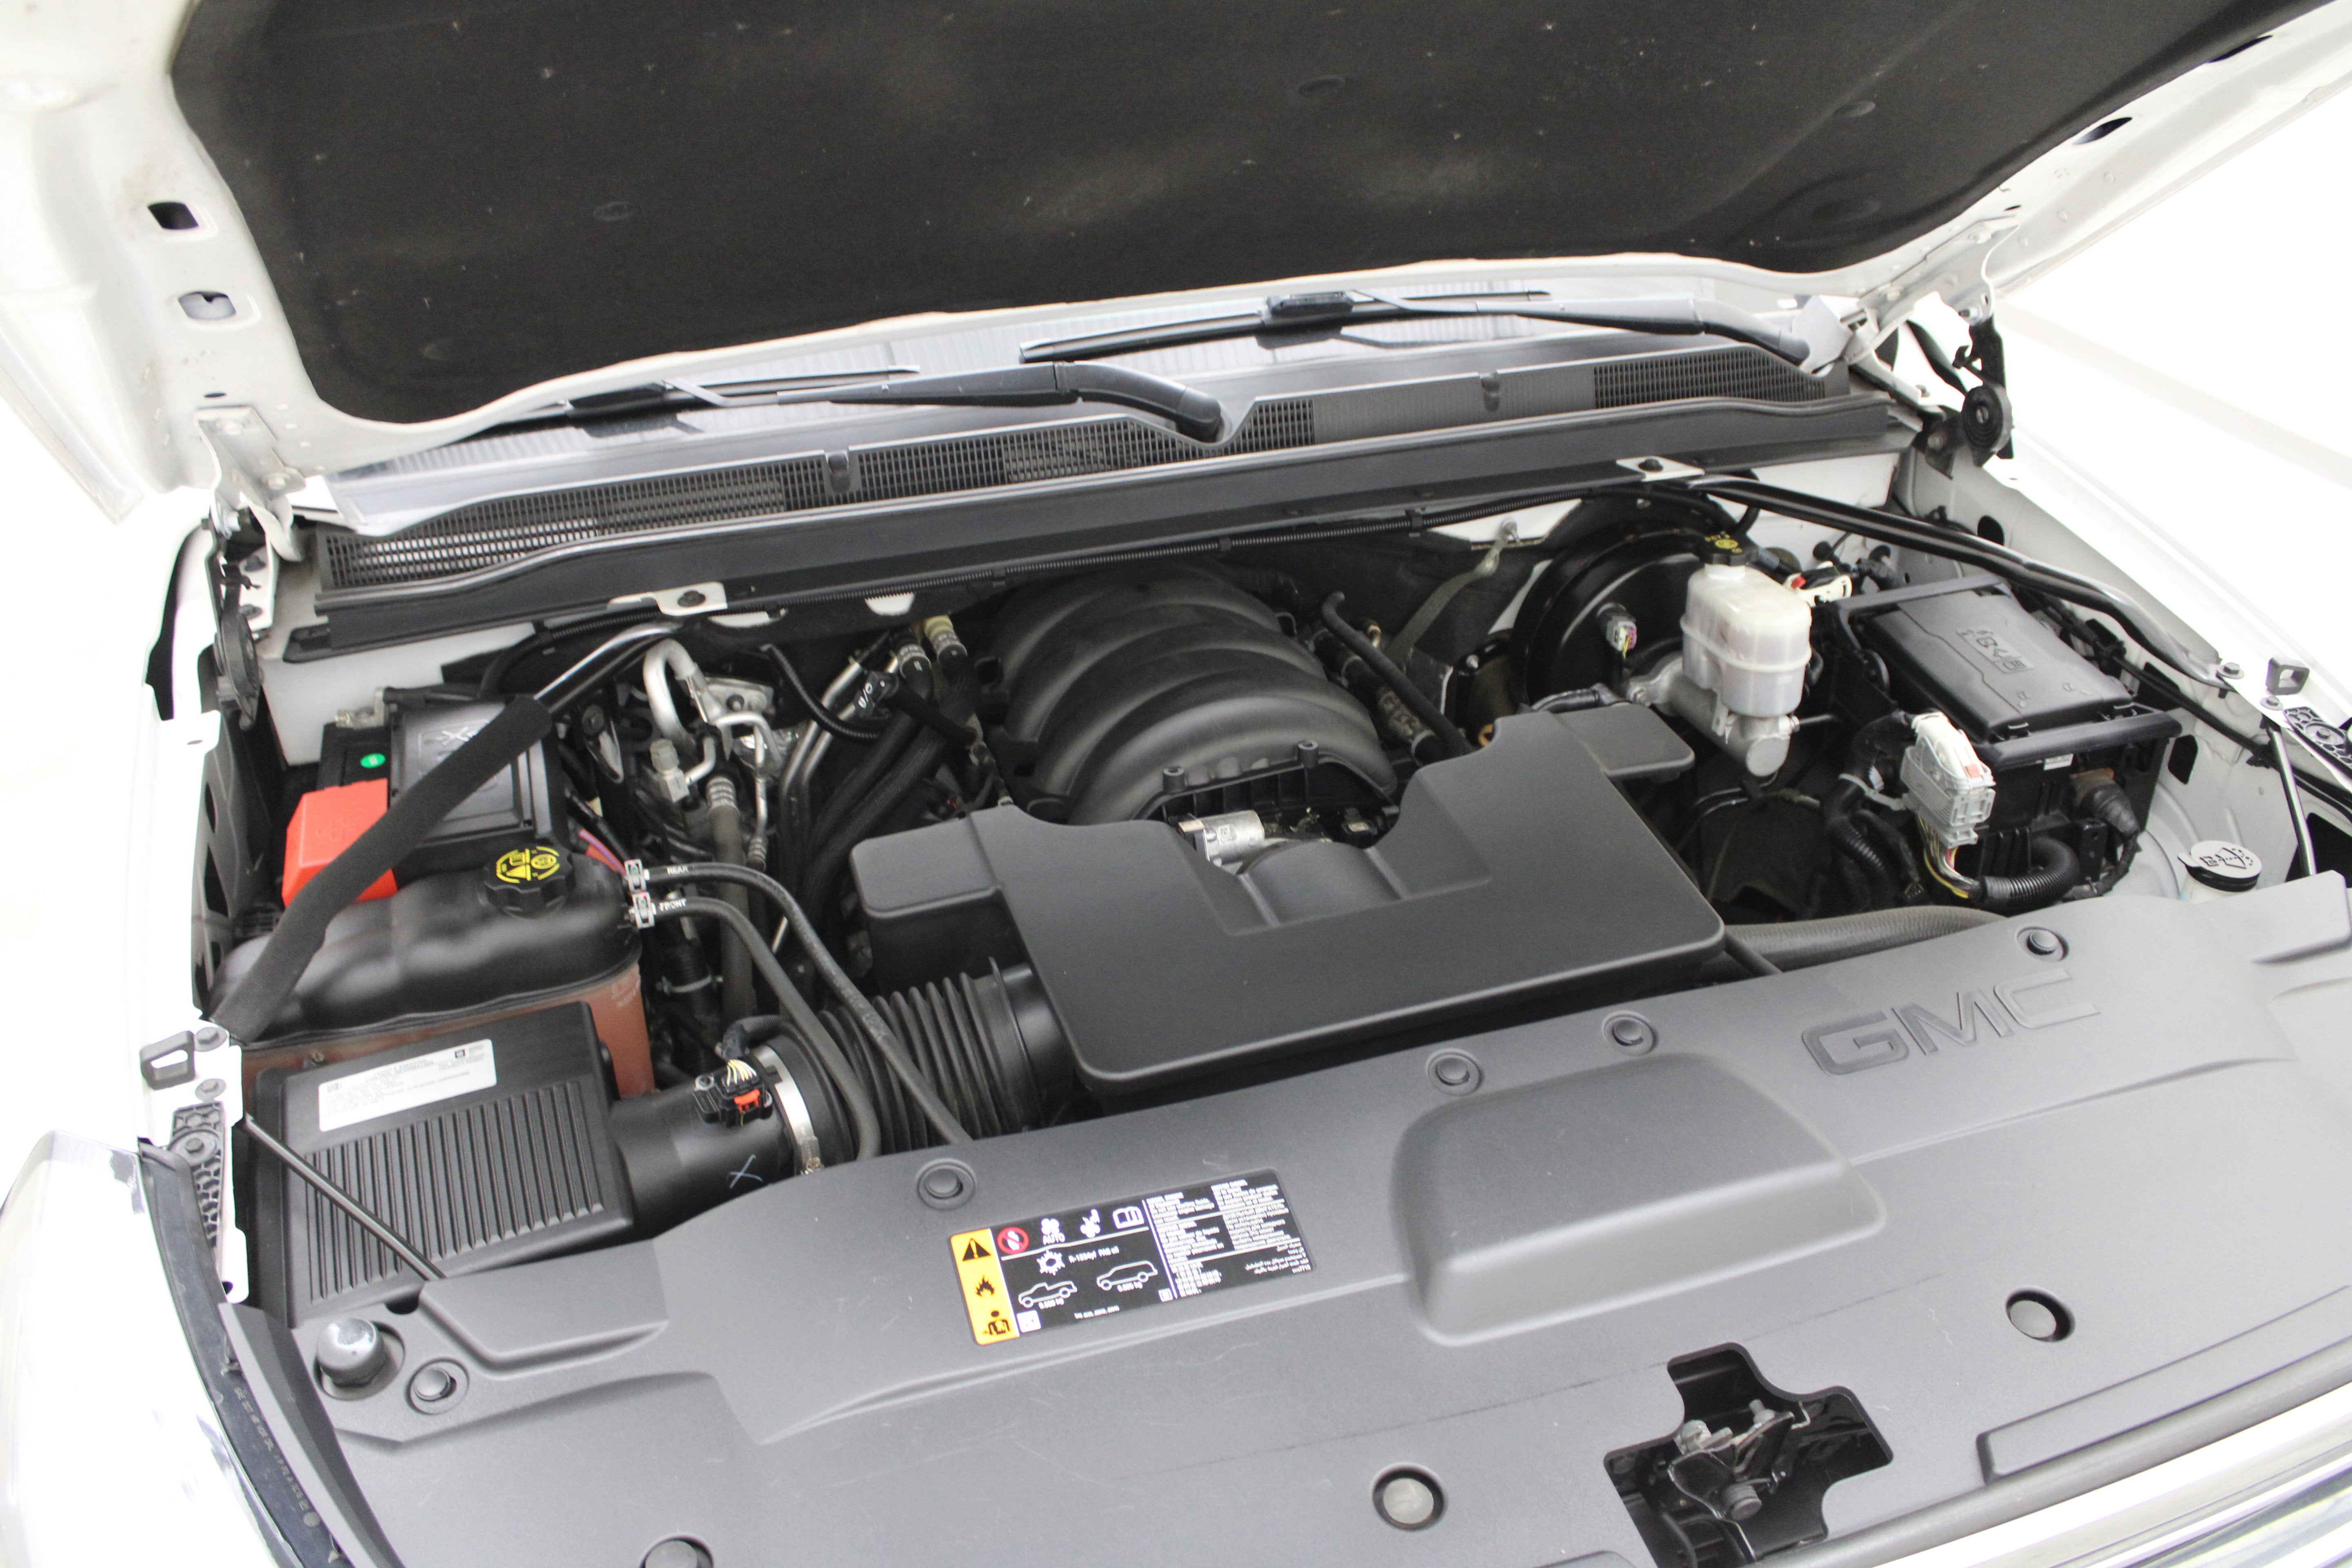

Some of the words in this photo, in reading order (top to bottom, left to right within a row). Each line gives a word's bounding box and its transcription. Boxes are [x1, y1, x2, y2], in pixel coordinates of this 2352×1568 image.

[666, 865, 689, 875] REAR
[659, 898, 686, 912] FRONT
[1801, 967, 2101, 1076] GMC
[1042, 1232, 1065, 1246] AUTO
